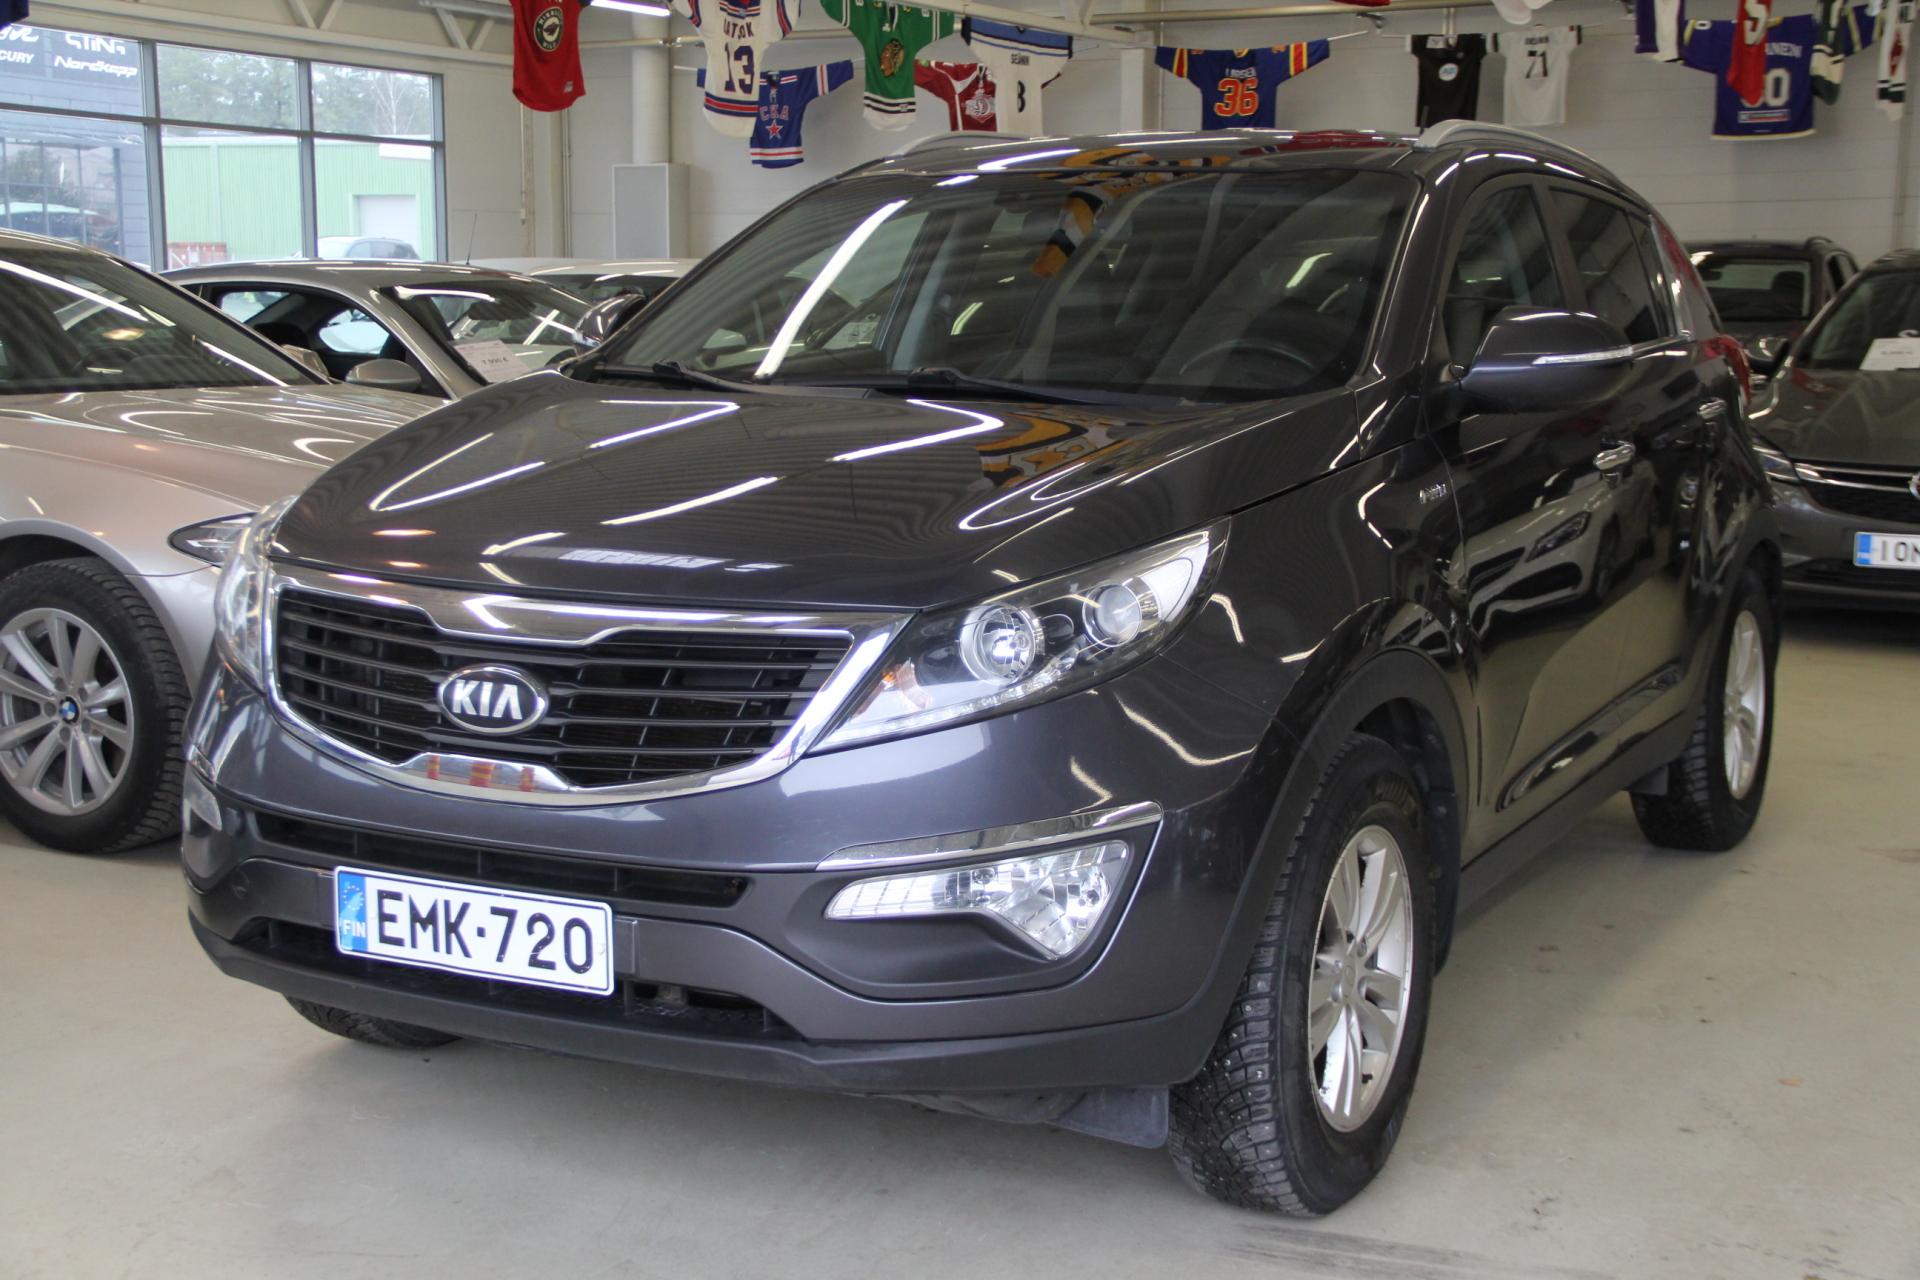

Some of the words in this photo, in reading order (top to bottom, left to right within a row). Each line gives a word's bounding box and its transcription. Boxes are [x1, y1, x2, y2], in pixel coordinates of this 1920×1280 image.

[53, 55, 138, 79] Nordkapp
[724, 42, 755, 94] 13
[1525, 49, 1548, 79] 71
[1214, 77, 1259, 116] 36
[452, 679, 523, 720] KIA
[342, 919, 367, 938] FIN
